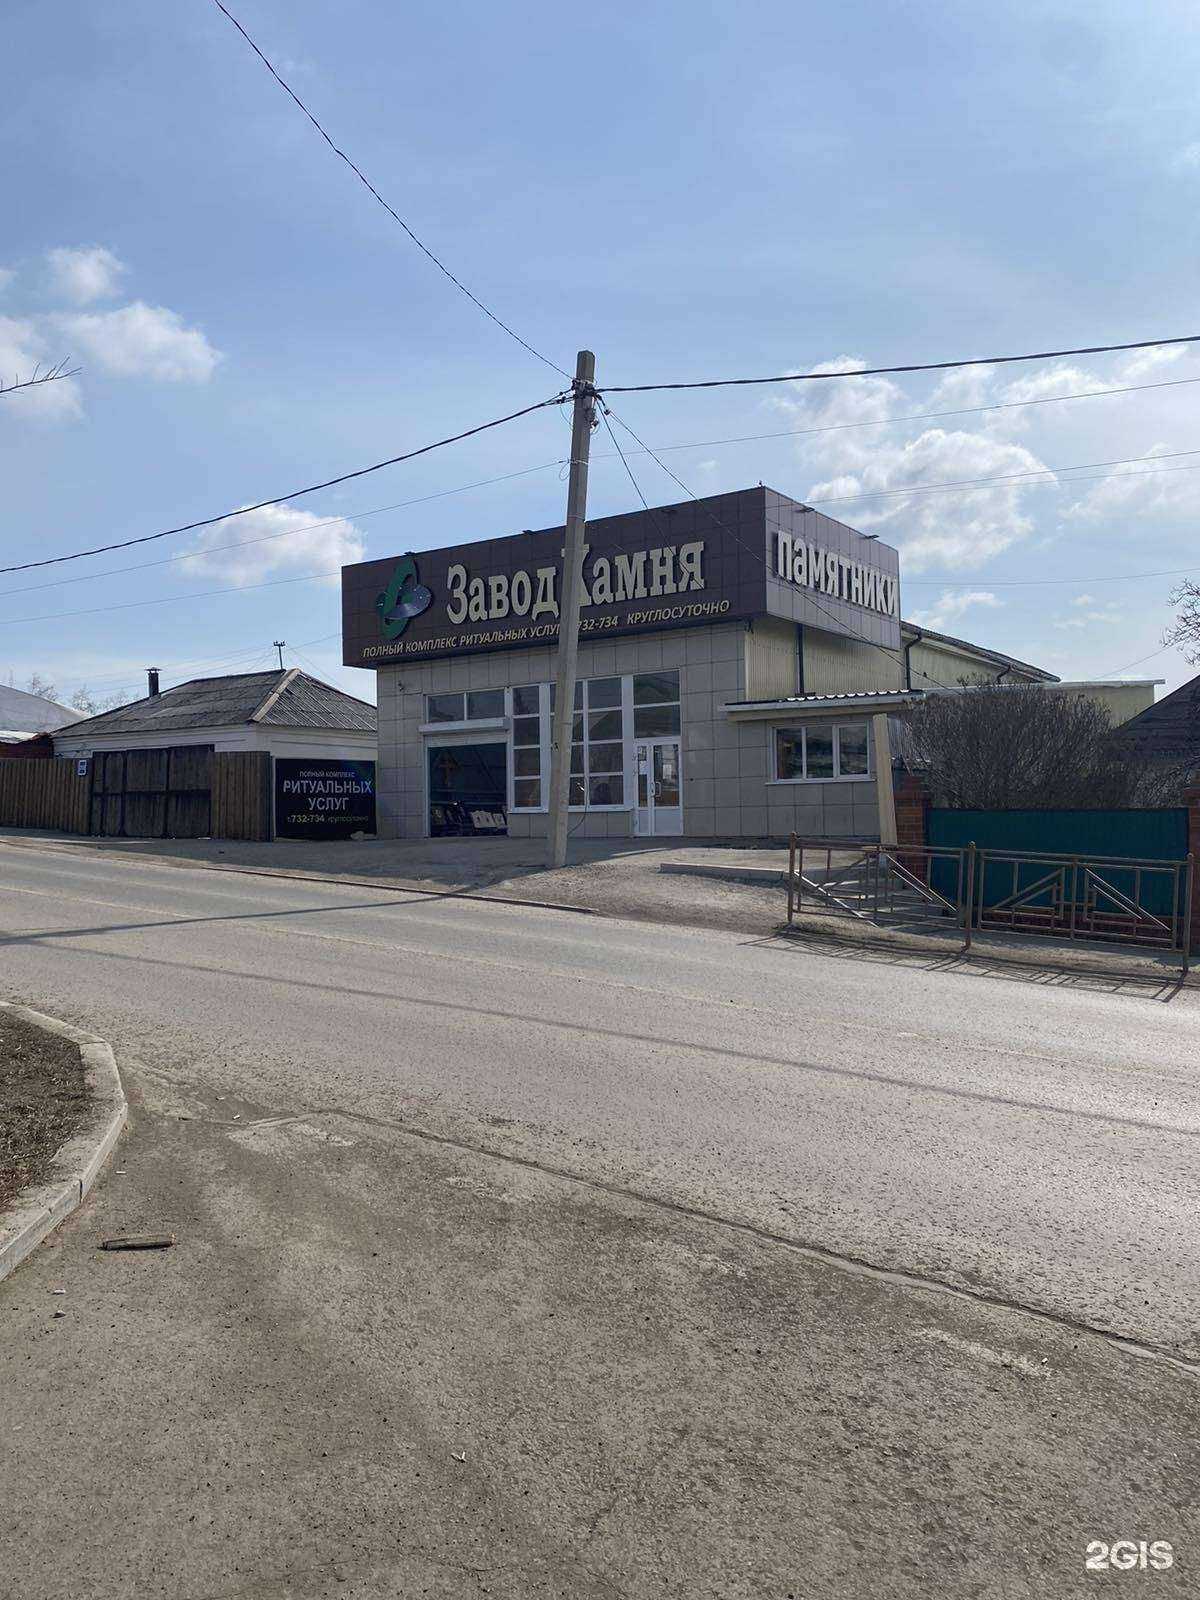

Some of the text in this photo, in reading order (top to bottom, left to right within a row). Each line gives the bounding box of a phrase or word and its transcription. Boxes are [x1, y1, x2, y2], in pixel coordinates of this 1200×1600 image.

[447, 564, 560, 624] Завод
[363, 641, 403, 658] ПОЛНЫЙ
[406, 636, 458, 653] КОМПЛЕКС
[460, 627, 527, 646] РИТУАЛЬНЫХ
[627, 600, 730, 625] КРУГЛОСУТОЧНО
[283, 780, 372, 794] РИТУАЛЬНЫХ
[308, 797, 349, 811] УСЛУГ
